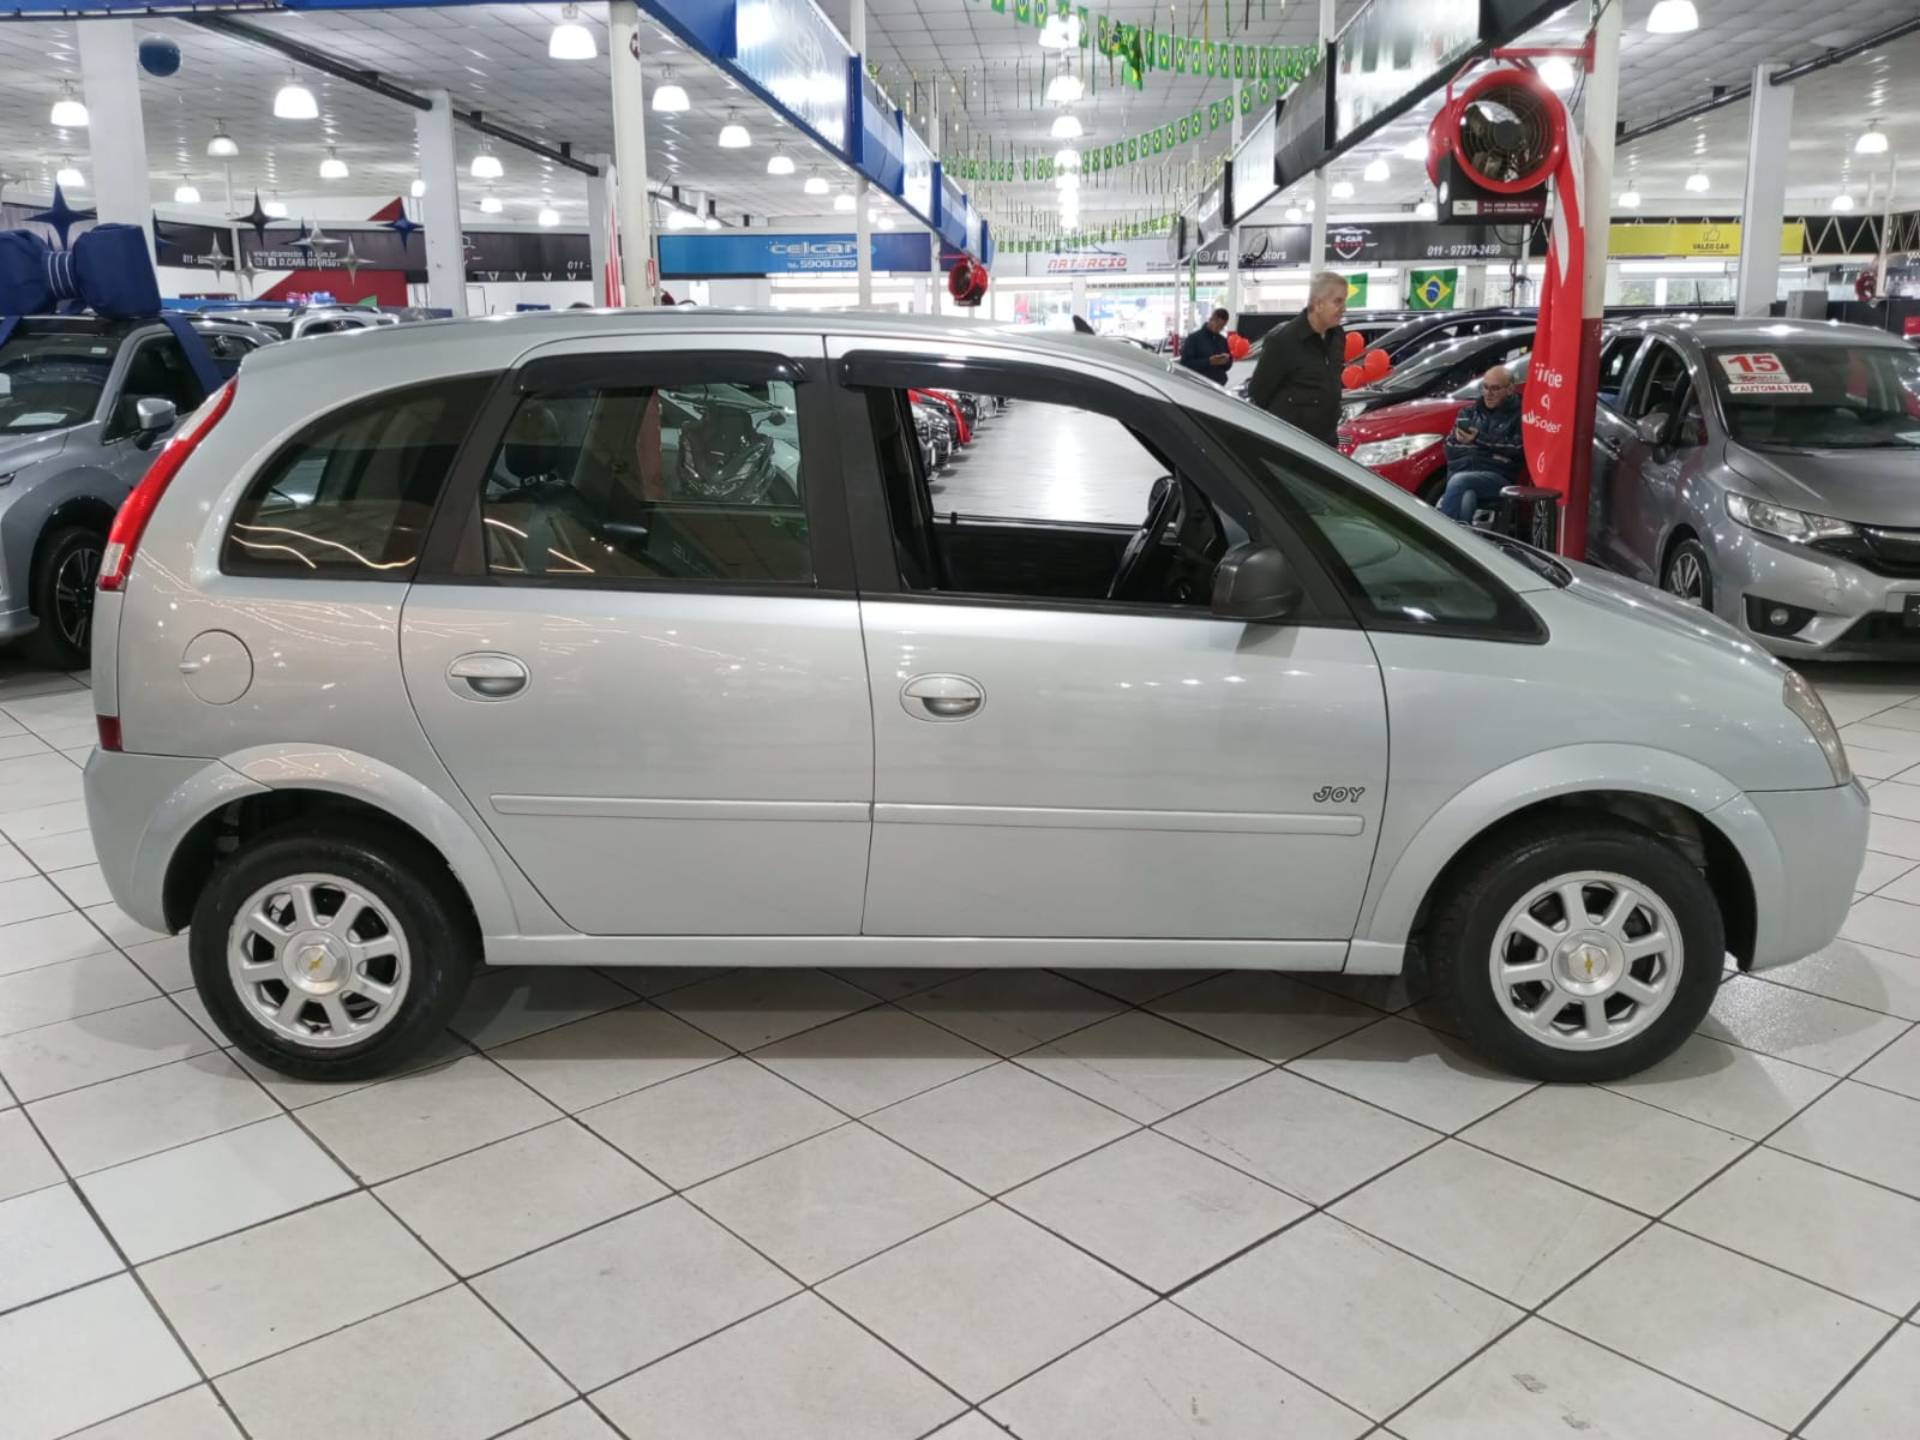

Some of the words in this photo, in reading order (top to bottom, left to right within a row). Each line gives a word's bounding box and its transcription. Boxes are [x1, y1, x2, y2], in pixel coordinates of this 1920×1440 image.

[1427, 246, 1442, 256] 011
[1727, 355, 1780, 373] 15
[1313, 785, 1366, 803] JOY
